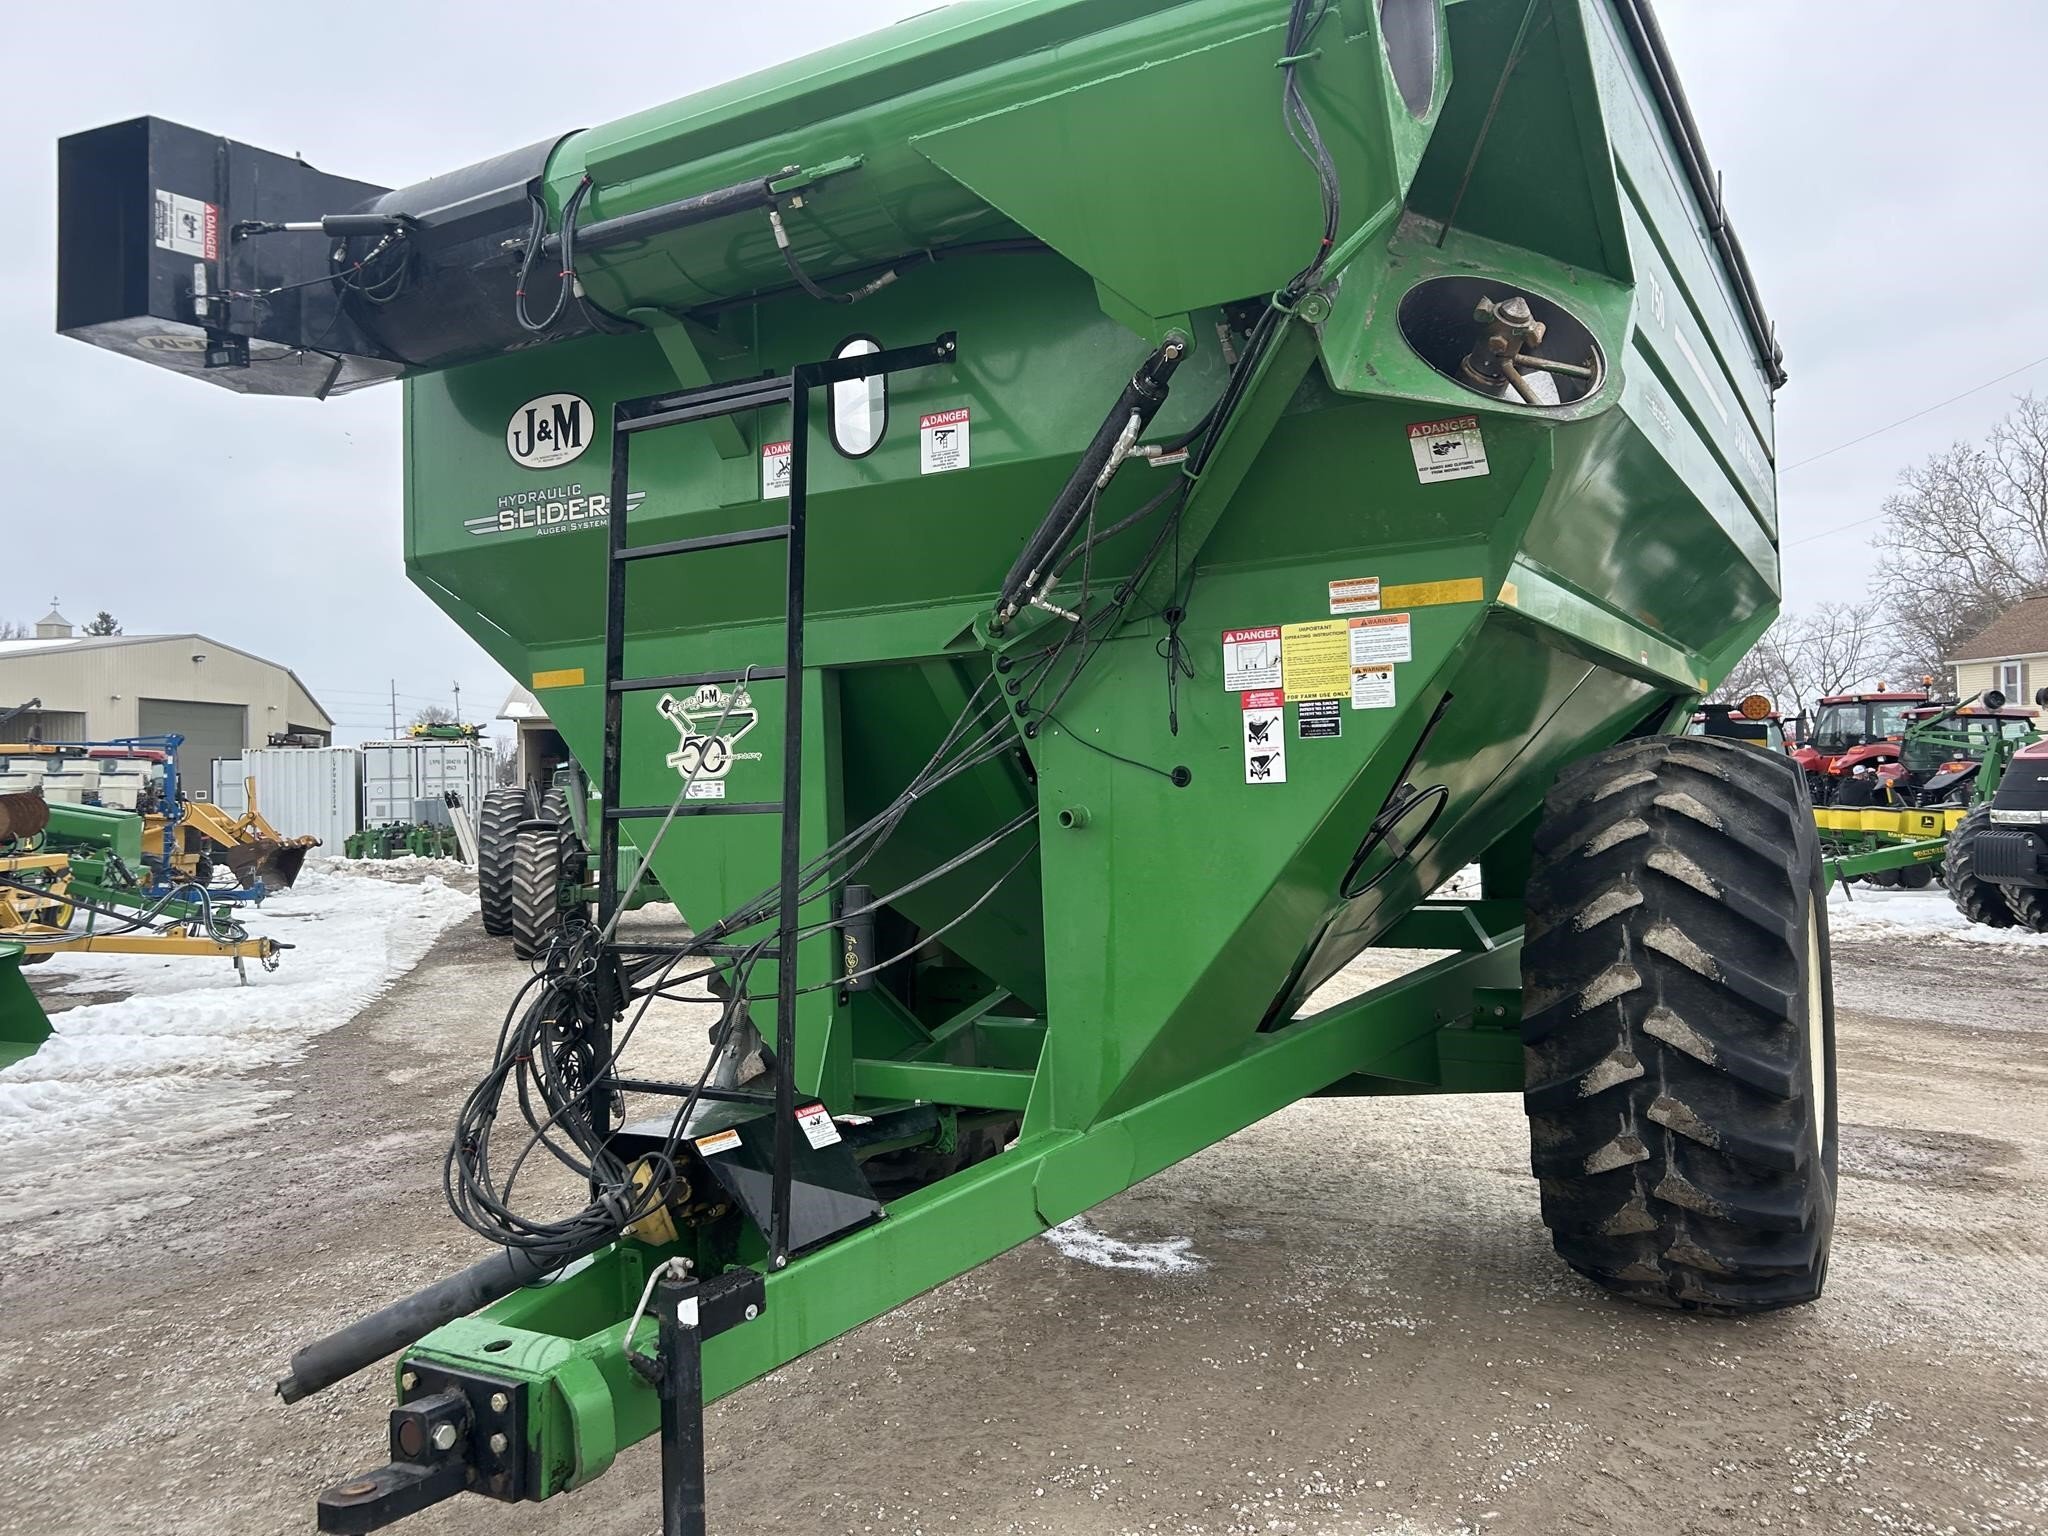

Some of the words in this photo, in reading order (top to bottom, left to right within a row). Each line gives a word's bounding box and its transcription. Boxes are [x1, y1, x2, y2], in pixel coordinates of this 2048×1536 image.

[205, 214, 217, 260] DANGER
[930, 410, 968, 425] DANGER
[513, 400, 583, 458] J&M
[1422, 418, 1477, 435] DANGER
[498, 484, 581, 508] HYDRAULIC
[498, 494, 607, 532] SLIDER
[536, 525, 567, 536] AUGER
[570, 519, 607, 531] SYSTEM
[1299, 624, 1332, 632] IMPORTANT
[1368, 617, 1398, 625] WARNING
[1236, 629, 1279, 641] DANGER
[1313, 630, 1347, 638] INSTRUCTIONS
[698, 689, 717, 704] J&M
[682, 736, 727, 775] 50
